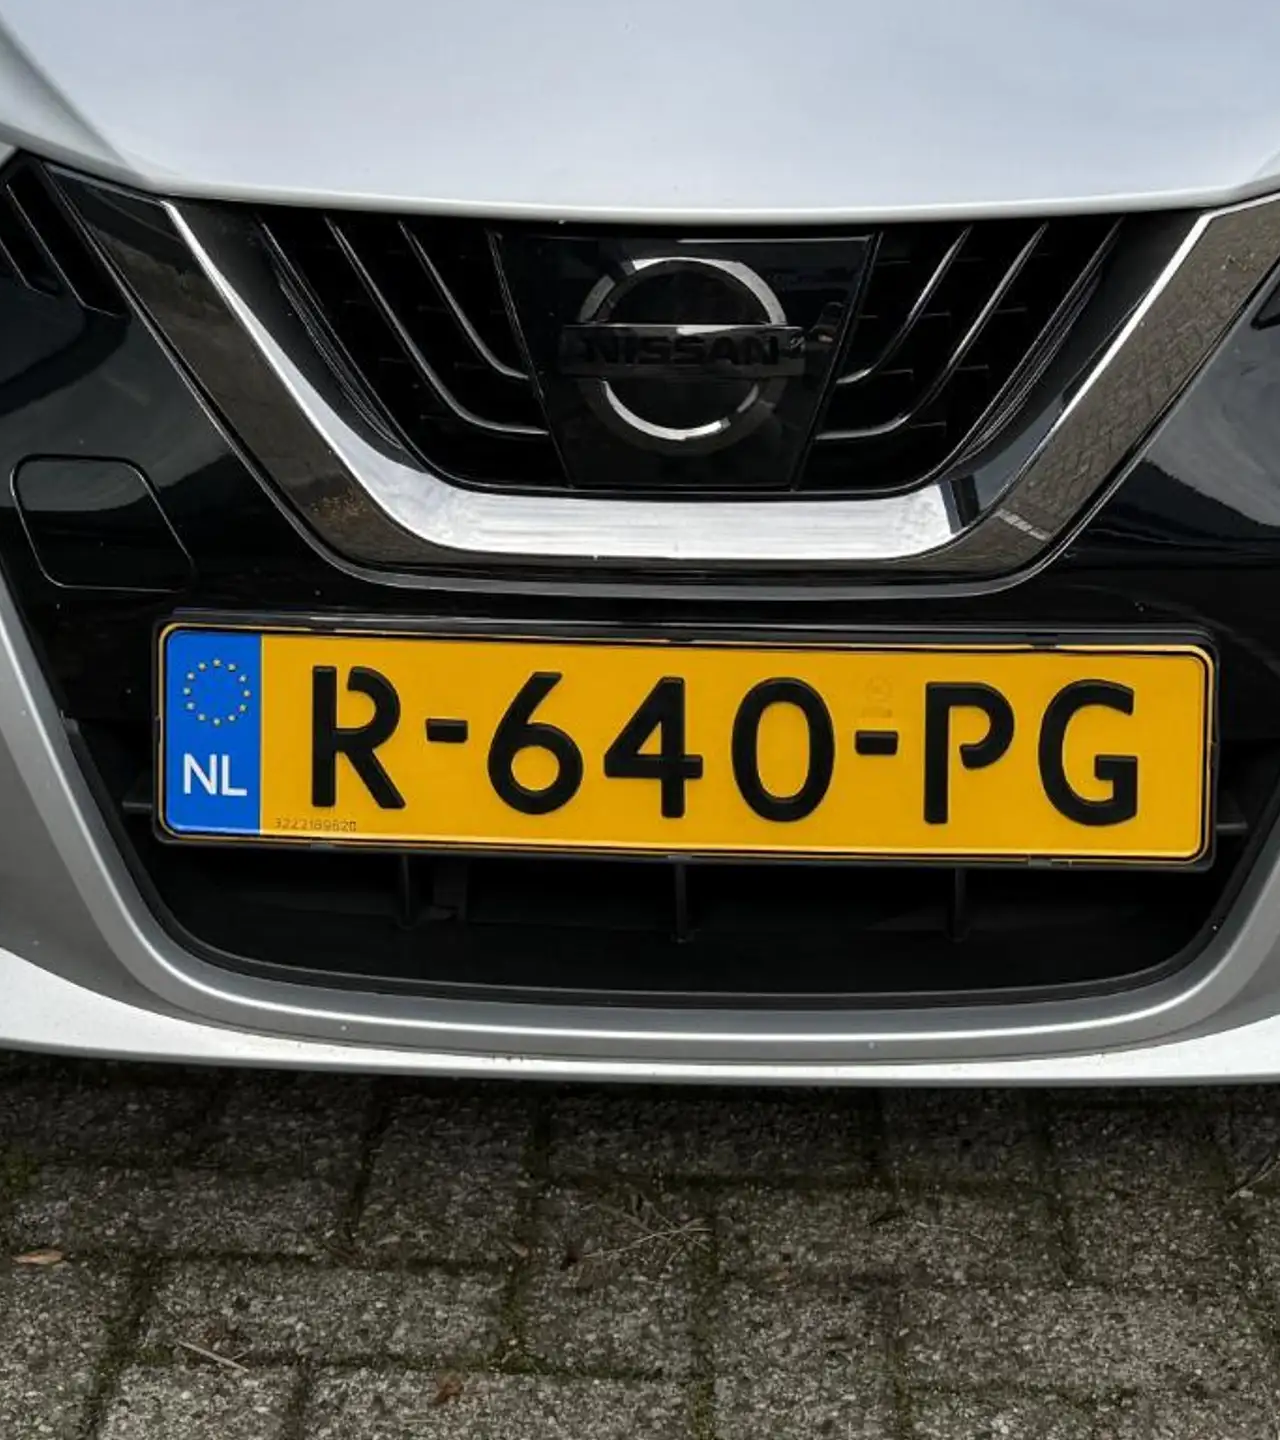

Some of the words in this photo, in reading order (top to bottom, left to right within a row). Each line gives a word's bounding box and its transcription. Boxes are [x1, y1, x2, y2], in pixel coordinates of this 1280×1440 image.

[583, 332, 780, 366] NISSAN
[310, 664, 1139, 828] R-640-PG
[183, 752, 248, 797] NL
